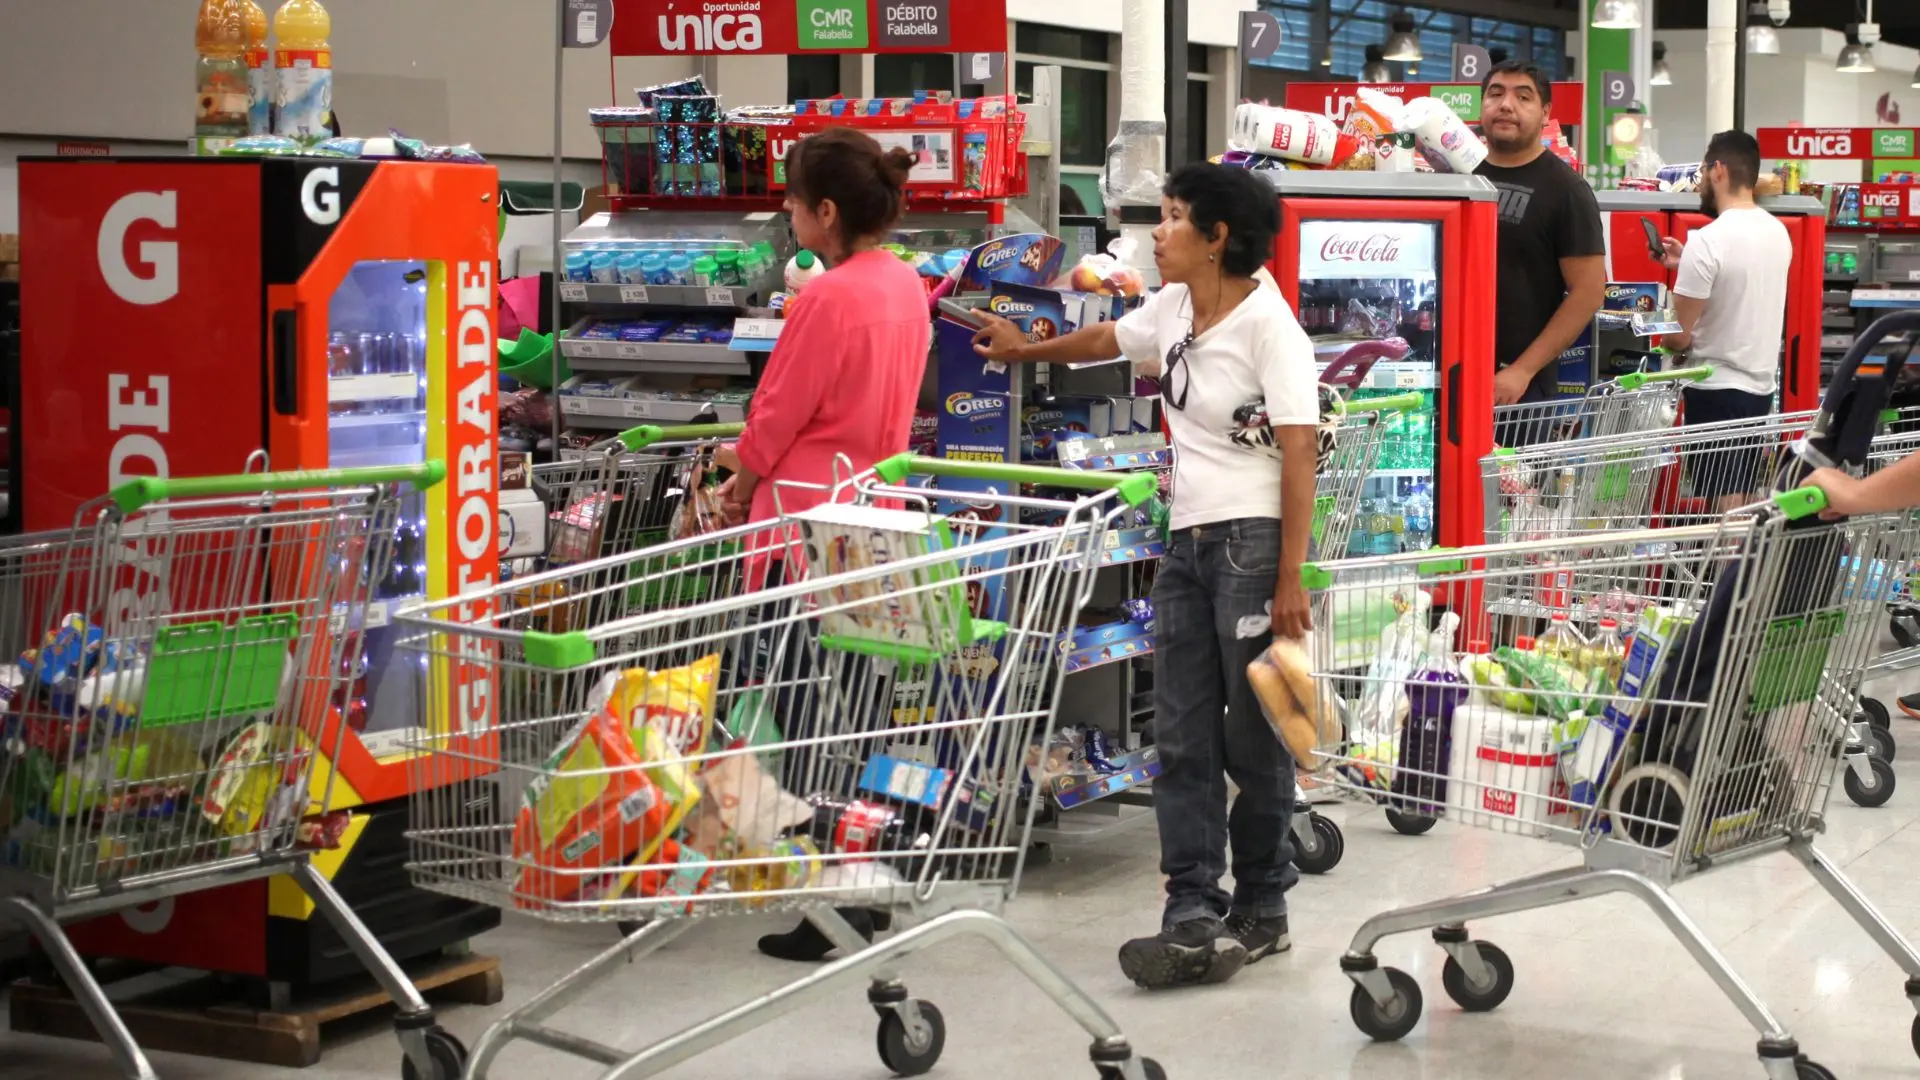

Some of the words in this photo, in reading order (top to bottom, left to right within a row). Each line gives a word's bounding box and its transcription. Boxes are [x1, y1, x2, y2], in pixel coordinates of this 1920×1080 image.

[703, 2, 761, 12] Oportunidad
[887, 3, 937, 21] DÉBITO
[810, 8, 853, 27] CMR
[658, 4, 762, 51] única
[814, 30, 853, 40] Falabella
[887, 23, 938, 36] Falabella
[1250, 23, 1267, 48] 7
[1461, 55, 1477, 77] 8
[1440, 92, 1472, 106] CMR
[1610, 80, 1625, 101] 9
[1787, 129, 1851, 156] única
[1880, 135, 1906, 146] CMR
[302, 167, 340, 225] G
[1863, 189, 1900, 206] única
[97, 190, 179, 304] G
[1320, 233, 1400, 261] Coca-Cola
[982, 247, 1018, 268] OREO
[1610, 288, 1637, 298] OREO
[997, 303, 1034, 313] OREO
[1558, 349, 1585, 359] REO
[955, 399, 1003, 415] OREO
[1028, 411, 1063, 423] OREO
[457, 261, 492, 741] GATORADE
